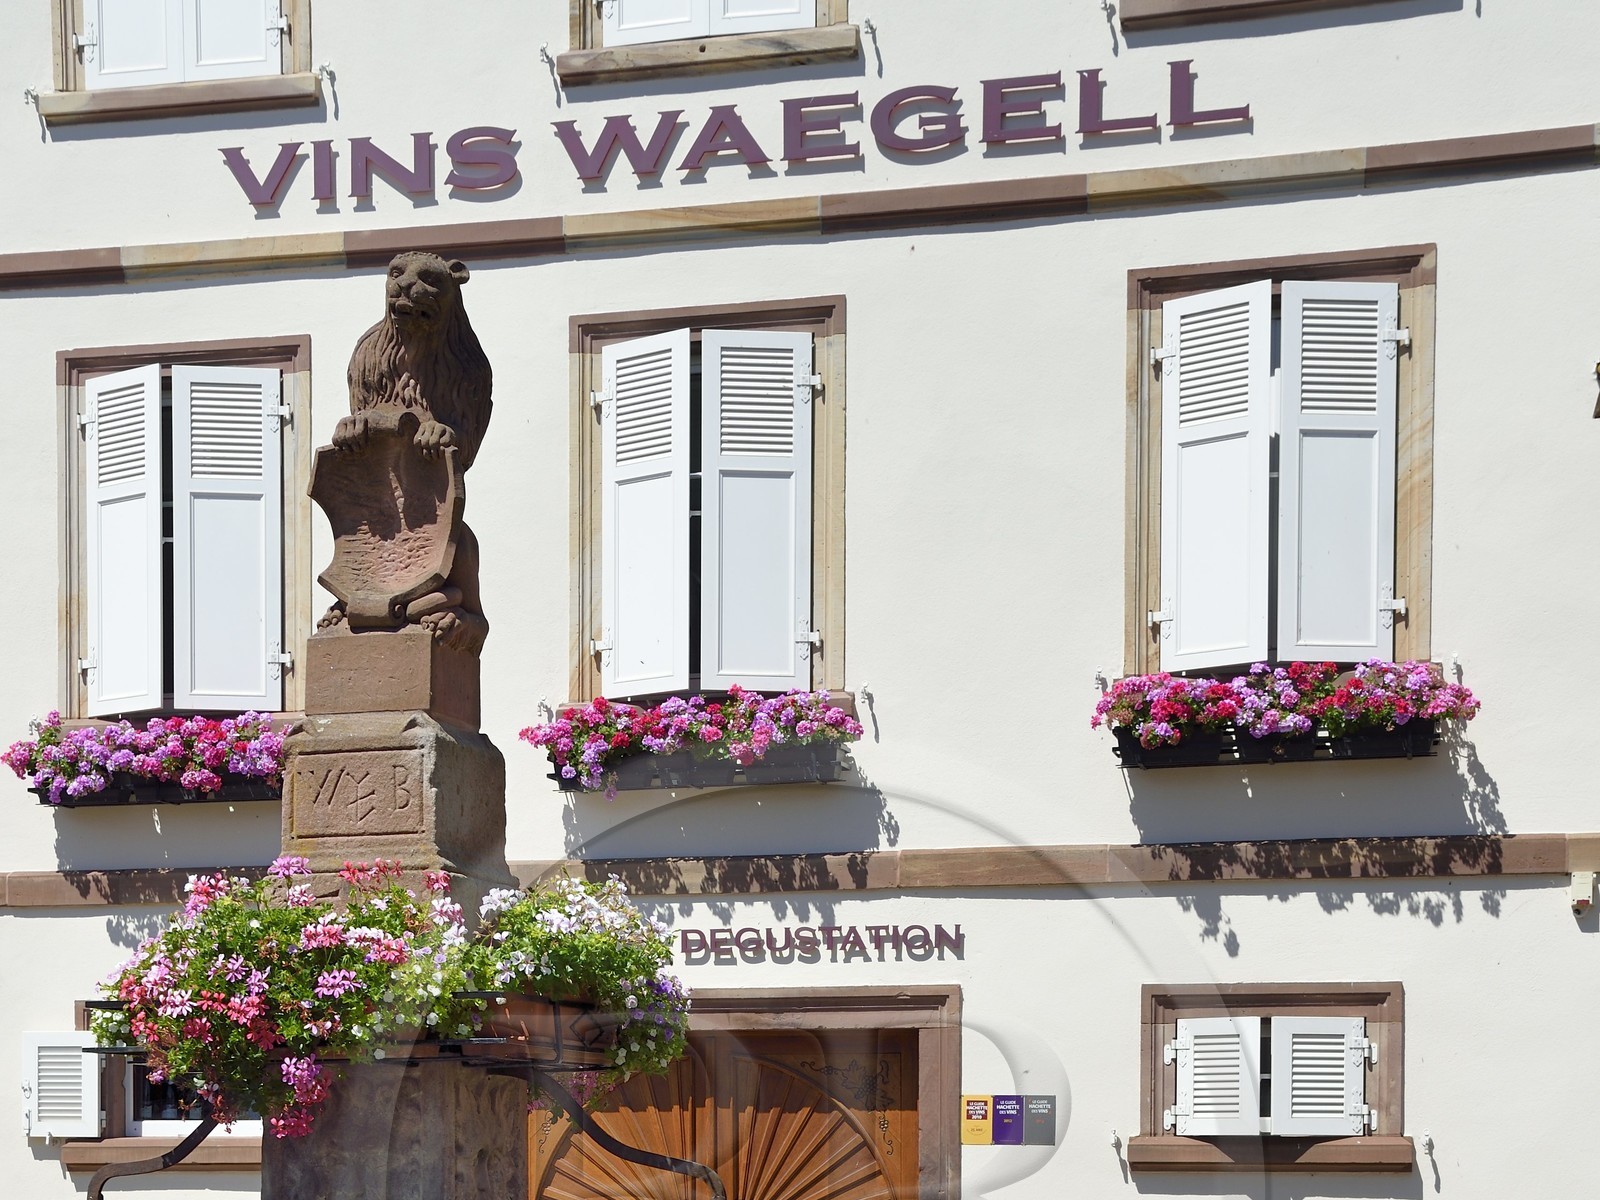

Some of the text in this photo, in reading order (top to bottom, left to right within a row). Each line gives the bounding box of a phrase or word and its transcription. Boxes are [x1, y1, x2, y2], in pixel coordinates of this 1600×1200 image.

[218, 59, 1250, 206] VINS WAEGELL
[680, 924, 963, 955] DEGUSTATION
